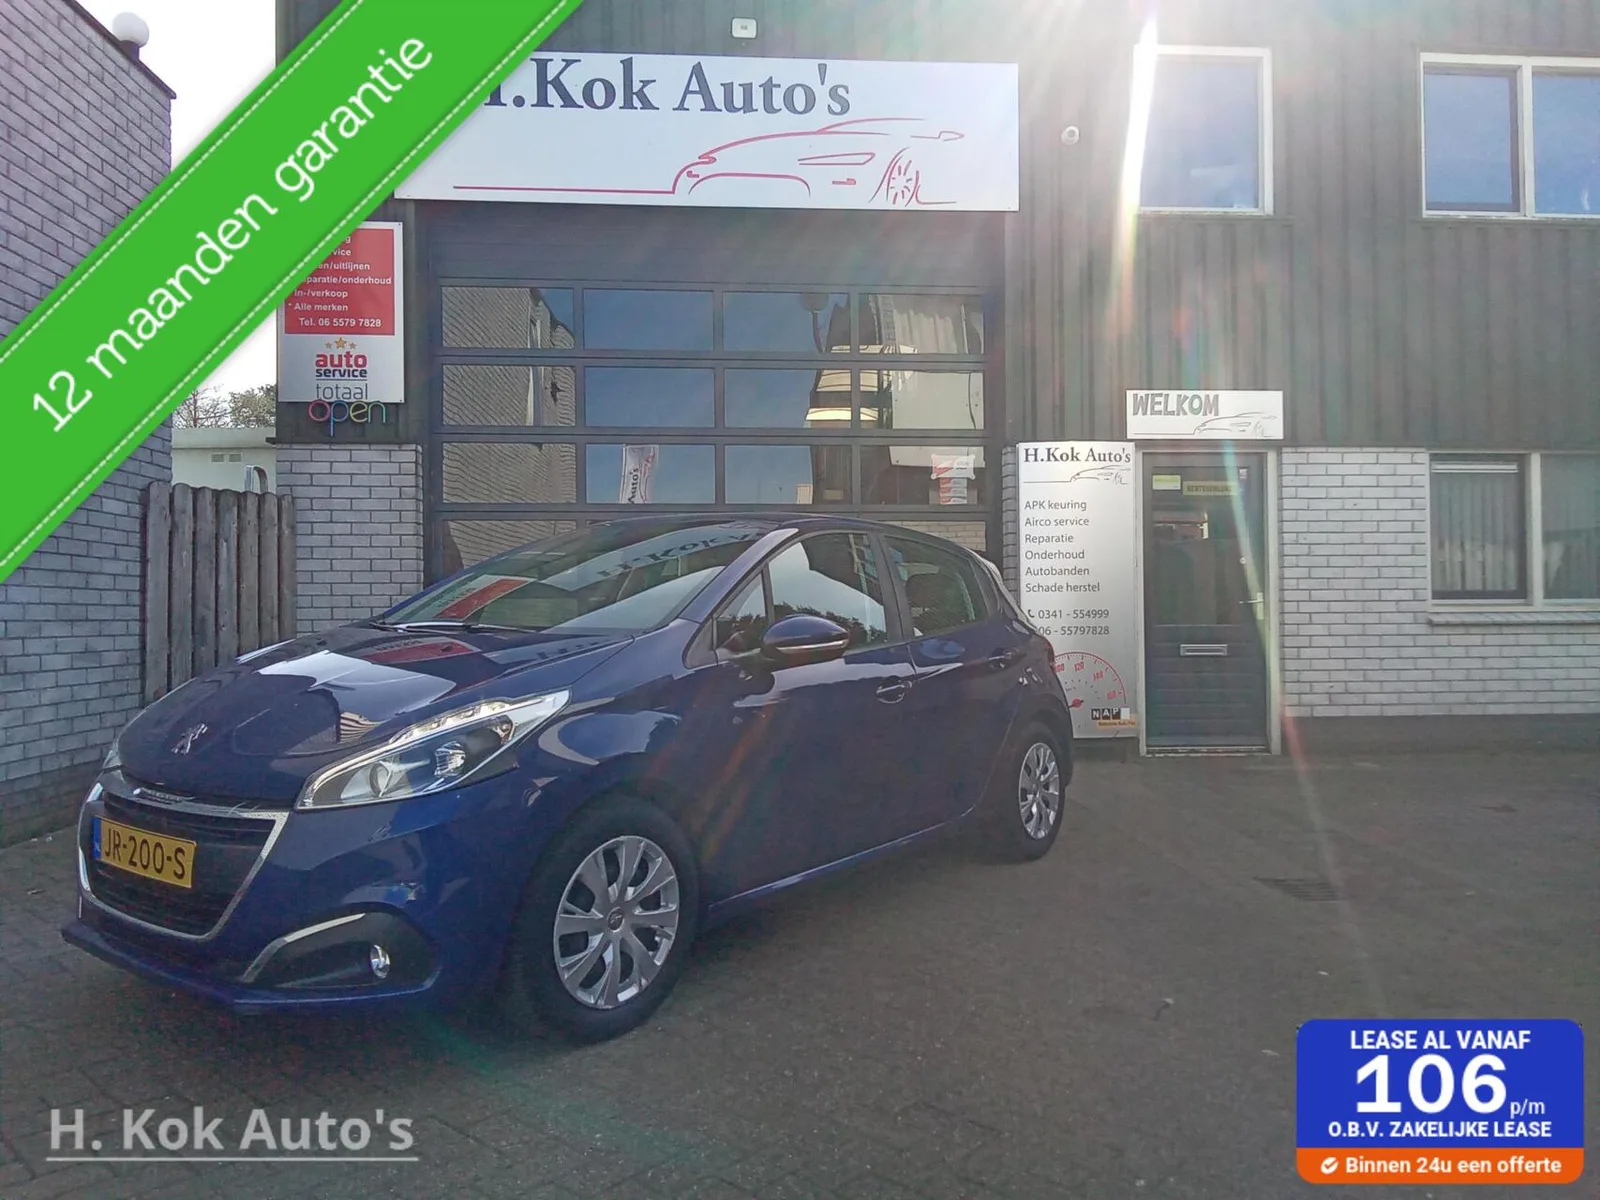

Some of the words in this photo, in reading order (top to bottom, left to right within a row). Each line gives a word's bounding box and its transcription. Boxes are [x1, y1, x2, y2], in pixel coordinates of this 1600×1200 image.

[484, 56, 660, 111] .Kok
[672, 63, 851, 116] Auto's
[304, 277, 392, 285] paratie/onderhoud
[299, 318, 316, 326] Tel.
[318, 318, 330, 326] 06
[332, 318, 356, 327] 5579
[359, 318, 382, 327] 7828
[315, 352, 367, 368] auto
[315, 368, 368, 378] service
[316, 383, 368, 400] totaal
[1132, 393, 1219, 417] WELKOM
[308, 400, 386, 437] open
[1024, 448, 1080, 463] H.Kok
[1084, 449, 1131, 463] Auto's
[1024, 500, 1046, 510] APK
[1048, 500, 1087, 512] keuring
[1024, 517, 1051, 527] Airco
[1054, 517, 1090, 526] service
[1024, 533, 1074, 545] Reparatie
[1024, 549, 1085, 560] Onderhoud
[1025, 566, 1090, 577] Autobanden
[1025, 583, 1063, 594] Schade
[1065, 583, 1100, 593] herstel
[1038, 609, 1063, 619] 0341
[1072, 609, 1109, 619] 554999
[1060, 625, 1110, 635] 55797828
[104, 828, 186, 880] JR-200-S
